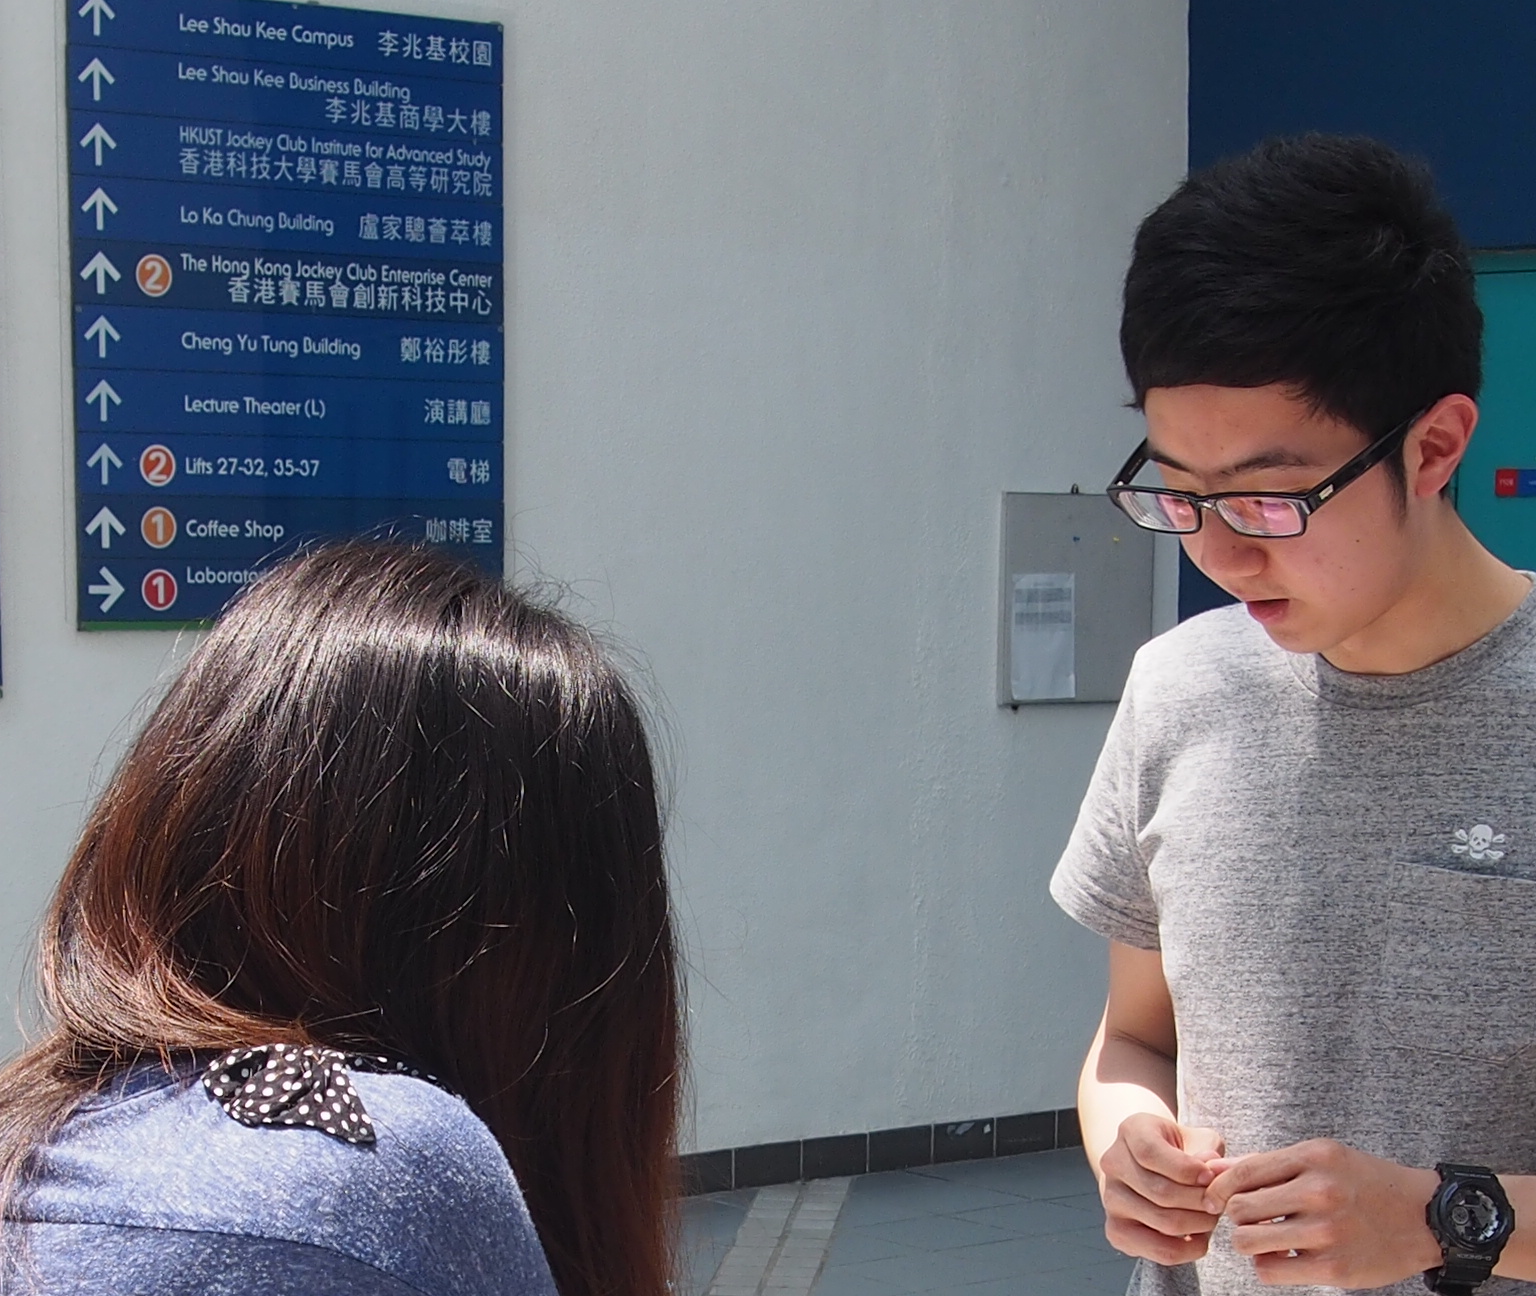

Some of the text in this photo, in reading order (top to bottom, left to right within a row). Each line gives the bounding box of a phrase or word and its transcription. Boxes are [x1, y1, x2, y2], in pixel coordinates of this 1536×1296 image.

[179, 14, 493, 67] Lee Shau Kee Campus 李兆基校園
[178, 62, 411, 103] Lee Shau Kee Business Building
[324, 97, 492, 137] 李兆基商學大樓
[179, 126, 491, 175] HKUST Jockey Club Institute for Advanced Study
[178, 148, 493, 198] 香港科技大學賽馬會高等研究院
[180, 207, 199, 224] Lo
[202, 208, 223, 226] Ka
[227, 210, 274, 232] Chung
[278, 212, 335, 237] Building
[180, 253, 493, 289] The Hong Kong Jockey Club Enterprise Center
[227, 276, 493, 316] 香港賽馬會創新科技中心
[181, 332, 492, 366] Cheng Yu Tung Building 鄭裕彤樓
[184, 396, 492, 426] Lecture Theater (L) 演講廳
[185, 457, 491, 486] Lifts 27-32, 35-37 電梯
[185, 517, 493, 545] Coffee Shop 咖啡室
[186, 566, 263, 584] Laborato
